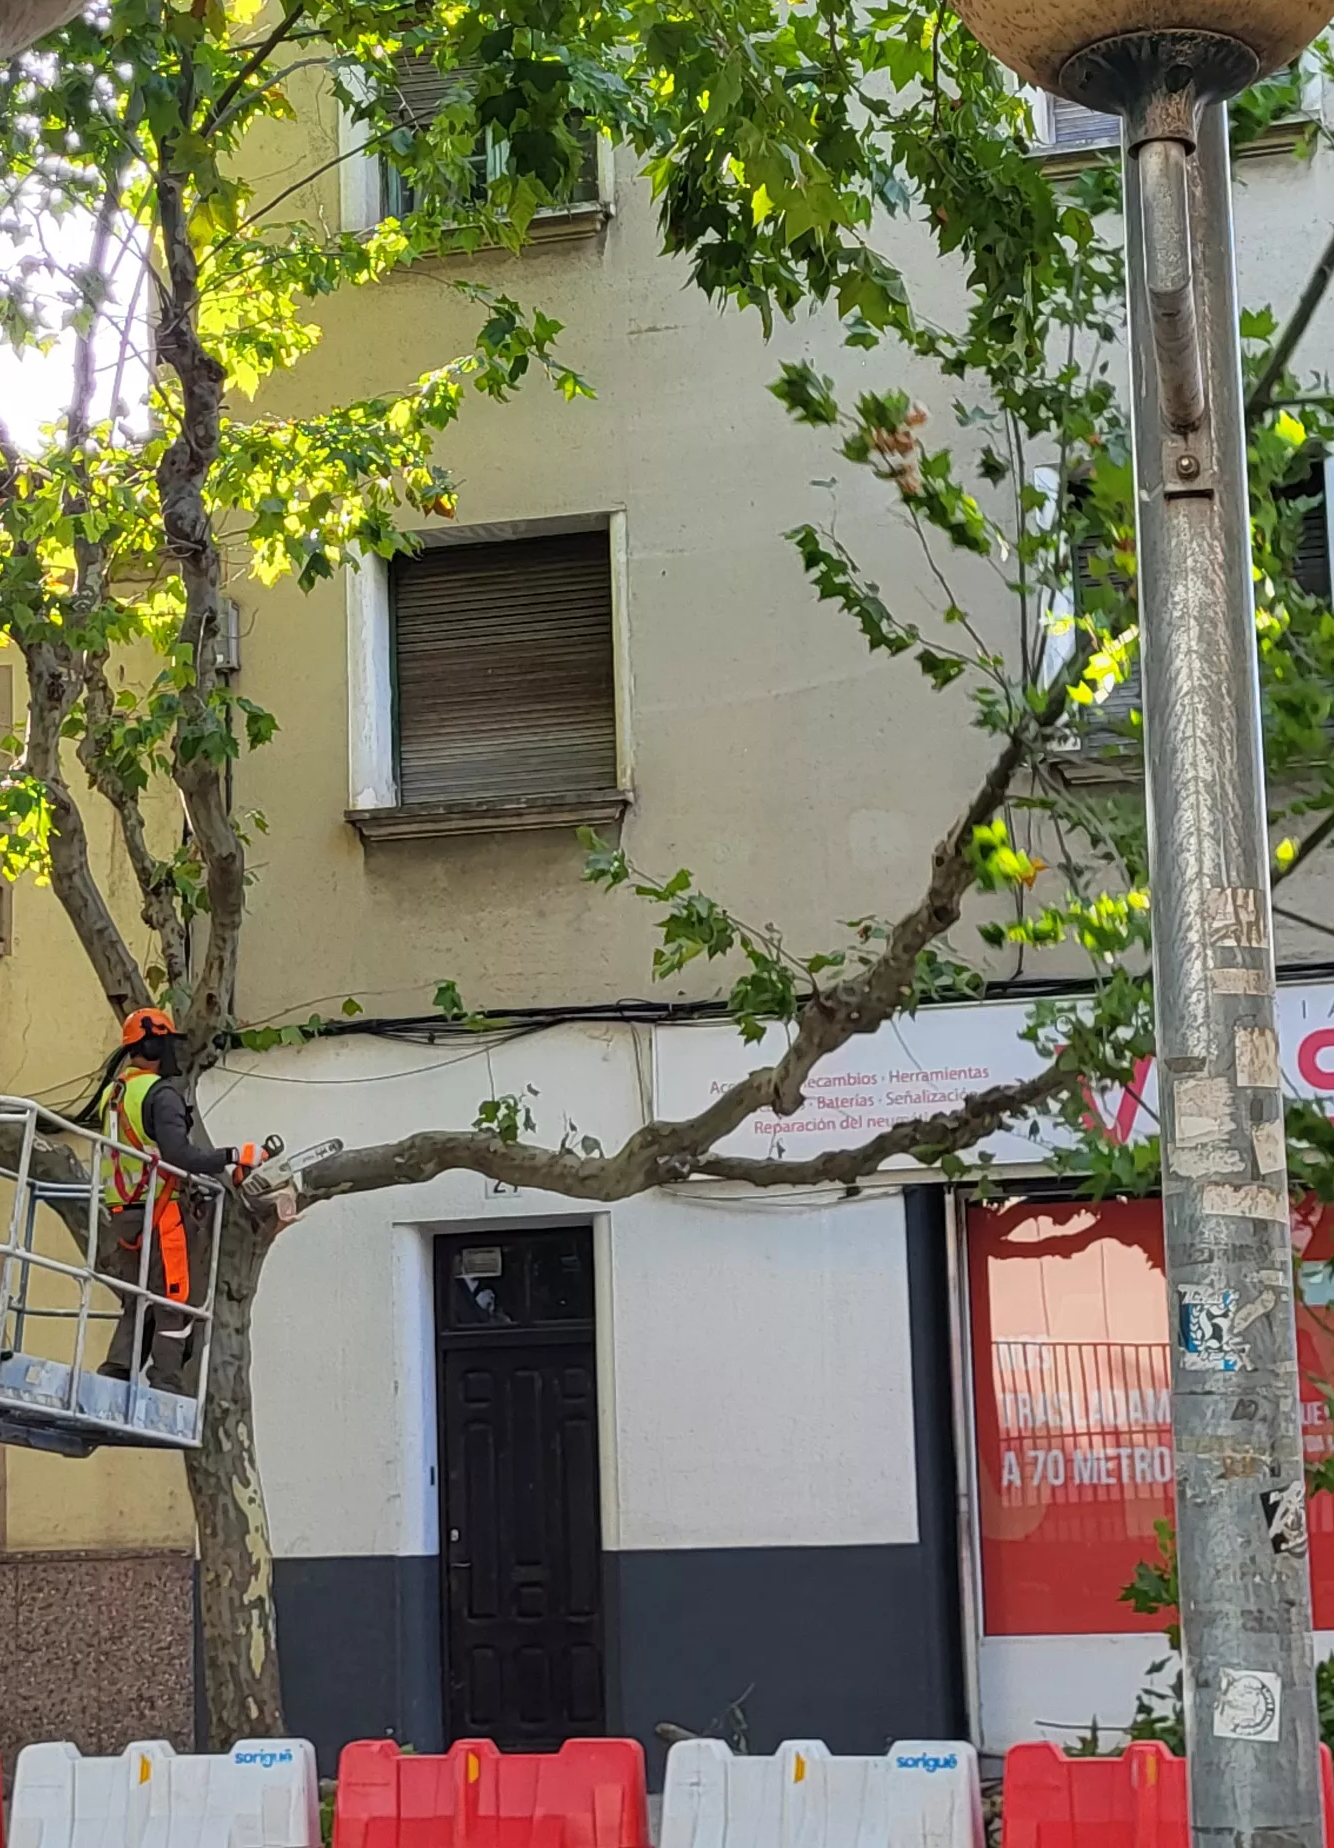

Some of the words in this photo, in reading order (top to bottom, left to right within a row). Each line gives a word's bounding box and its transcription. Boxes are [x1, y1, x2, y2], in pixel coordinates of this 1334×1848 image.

[802, 1071, 878, 1090] ecambios
[888, 1065, 990, 1085] Herramientas
[817, 1093, 875, 1110] Baterías
[753, 1117, 837, 1136] Reparación
[841, 1114, 863, 1130] del
[1000, 1387, 1172, 1430] TRASLADAM
[1001, 1450, 1022, 1489] A
[1027, 1448, 1066, 1488] 70
[1073, 1446, 1174, 1486] METRO
